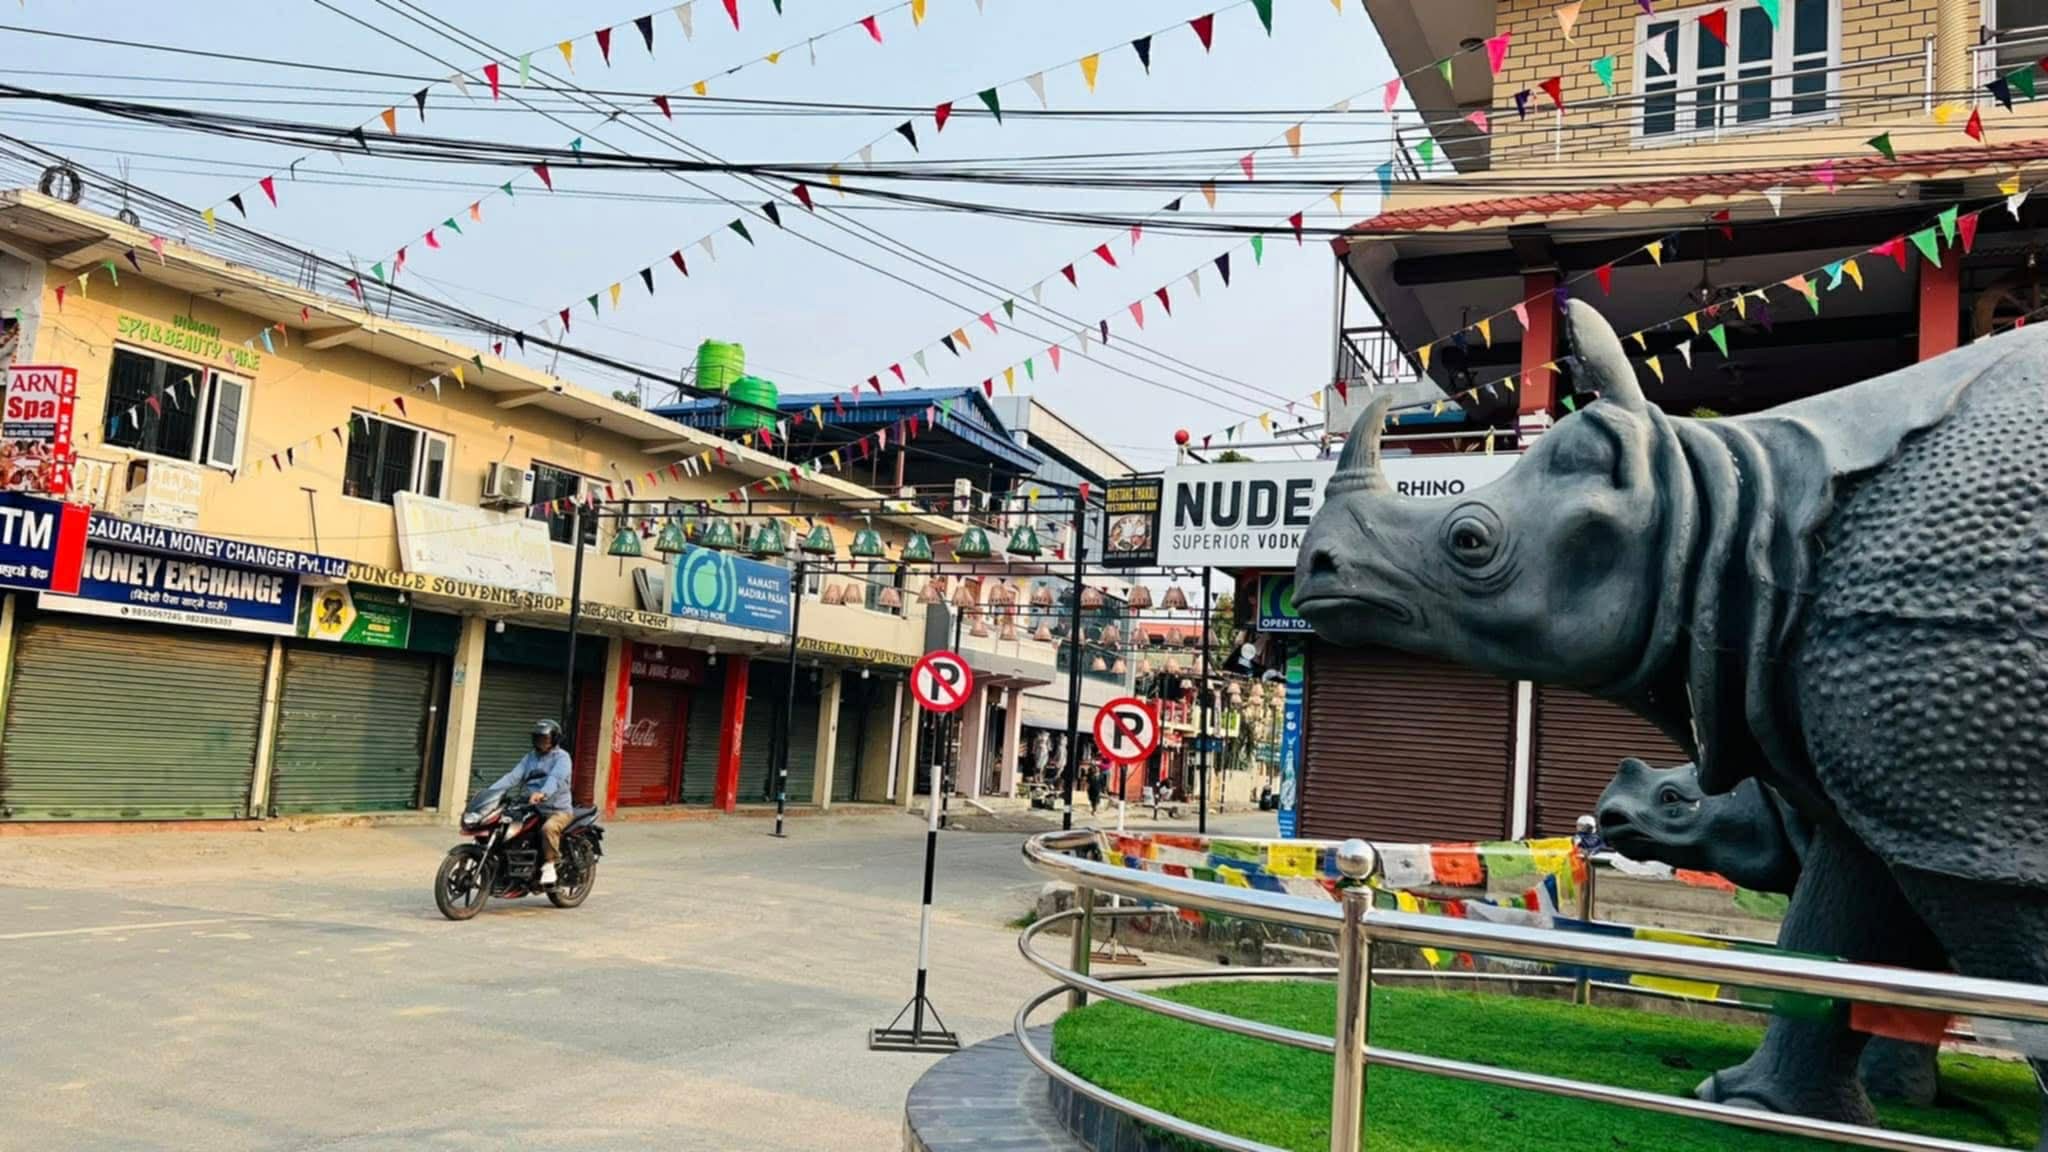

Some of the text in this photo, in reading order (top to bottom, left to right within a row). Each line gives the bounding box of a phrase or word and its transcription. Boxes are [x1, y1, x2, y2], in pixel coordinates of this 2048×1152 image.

[118, 315, 149, 341] SPA
[151, 325, 162, 342] &
[164, 329, 222, 358] BEAUTY
[11, 373, 57, 393] ARN
[7, 396, 55, 420] Spa
[1397, 479, 1465, 496] RHINO
[1175, 479, 1314, 528] NUDE
[88, 516, 165, 548] SAURAHA
[169, 532, 224, 557] MONEY
[226, 541, 295, 569] CHANGER
[1173, 533, 1300, 550] SUPERIOR VODK
[164, 560, 283, 605] EXCHANGE
[350, 564, 565, 611] JUNGLE SOUVENIR SHOP
[738, 586, 766, 600] MADIRA
[747, 575, 780, 592] NAMASTE
[682, 606, 699, 617] OPEN
[700, 609, 709, 618] TO
[1262, 618, 1306, 628] OPEN TO
[931, 661, 960, 701] P
[1113, 711, 1144, 749] P
